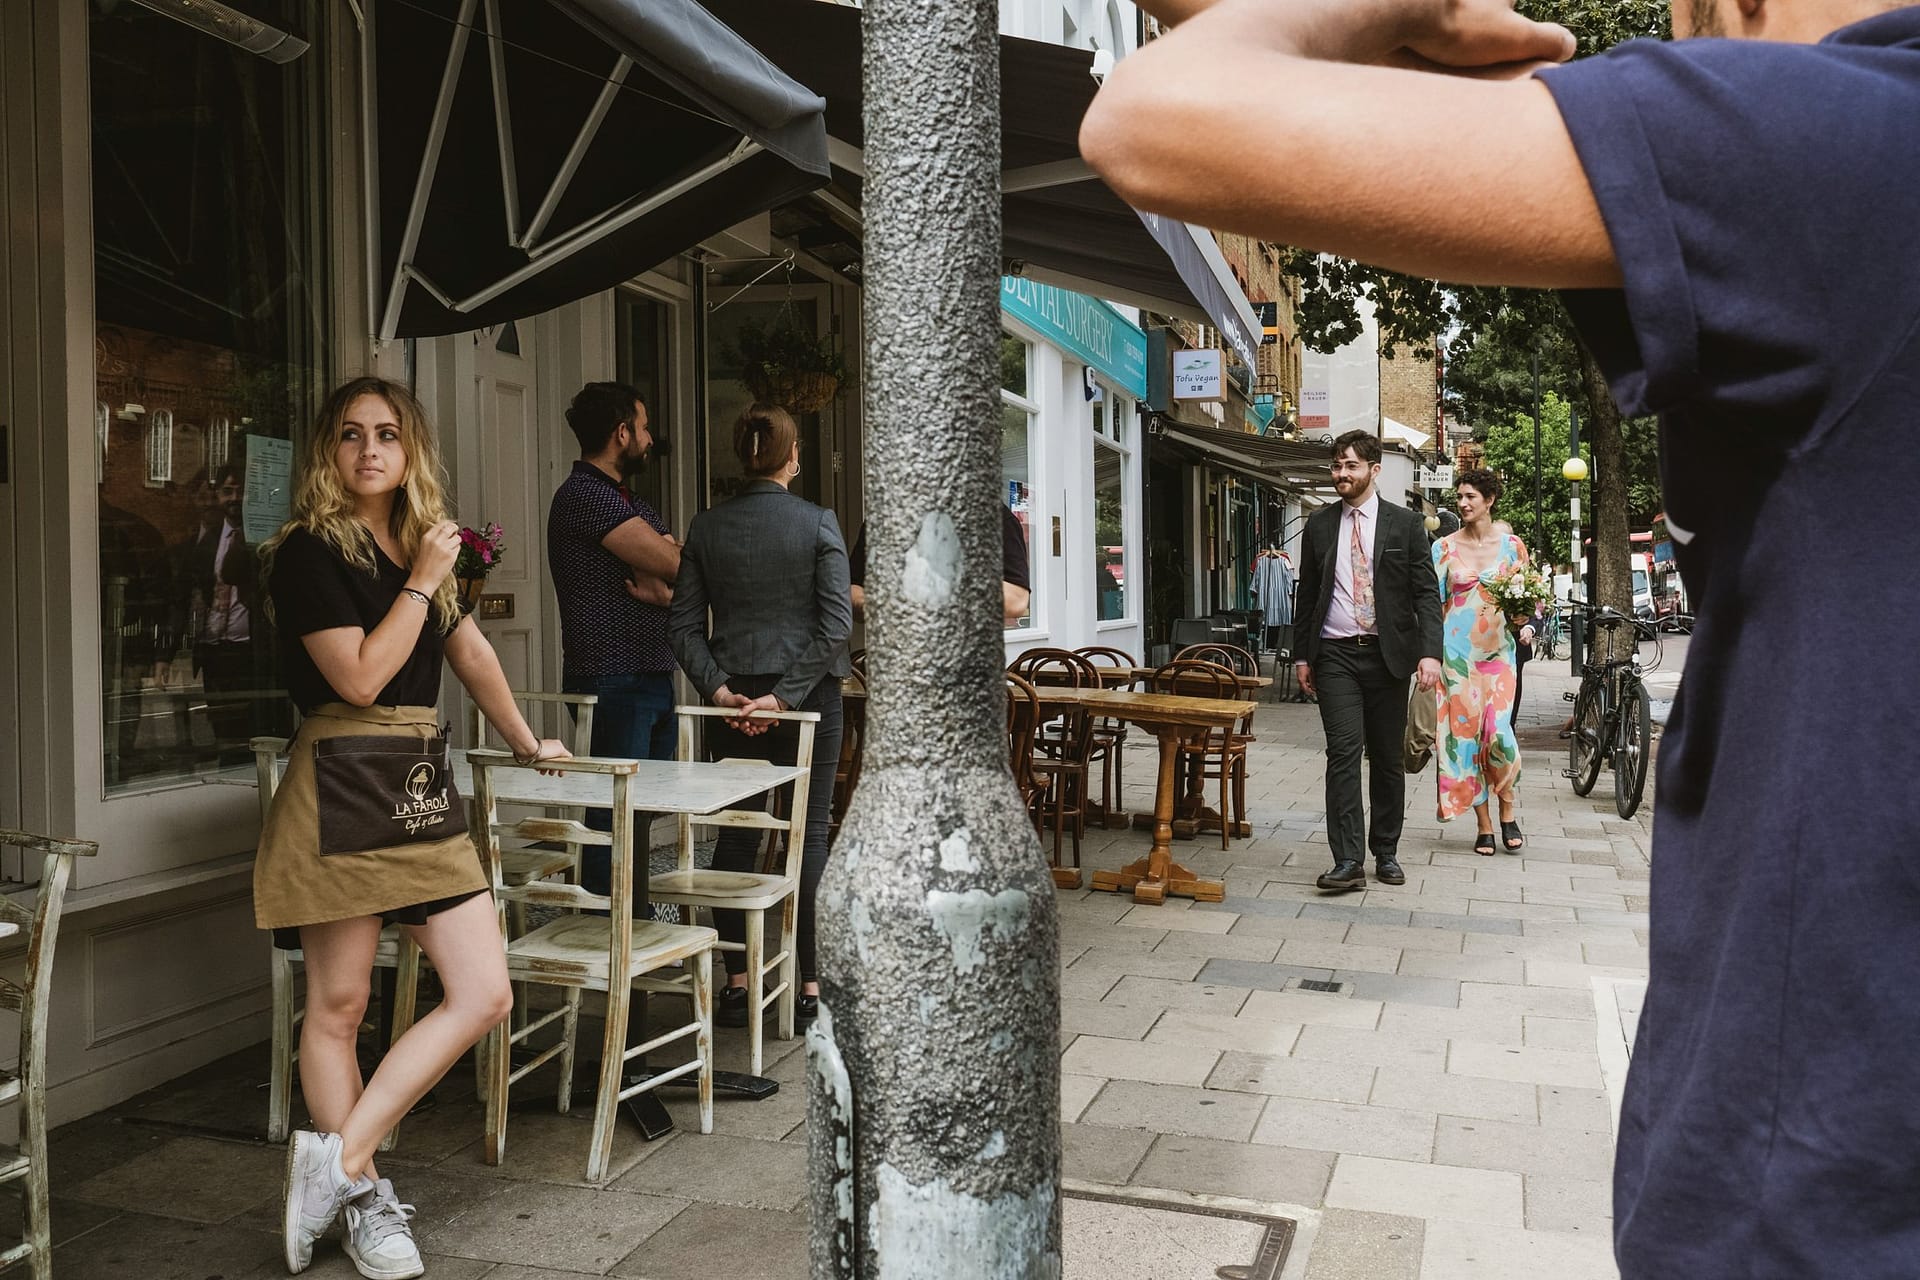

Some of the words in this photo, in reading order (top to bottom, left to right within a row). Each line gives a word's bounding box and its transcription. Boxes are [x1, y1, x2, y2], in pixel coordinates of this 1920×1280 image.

[1065, 289, 1113, 365] SURGERY
[1175, 374, 1193, 383] Tofu
[1195, 374, 1219, 384] Vegan
[395, 802, 412, 815] LA
[413, 796, 449, 813] FAROLA
